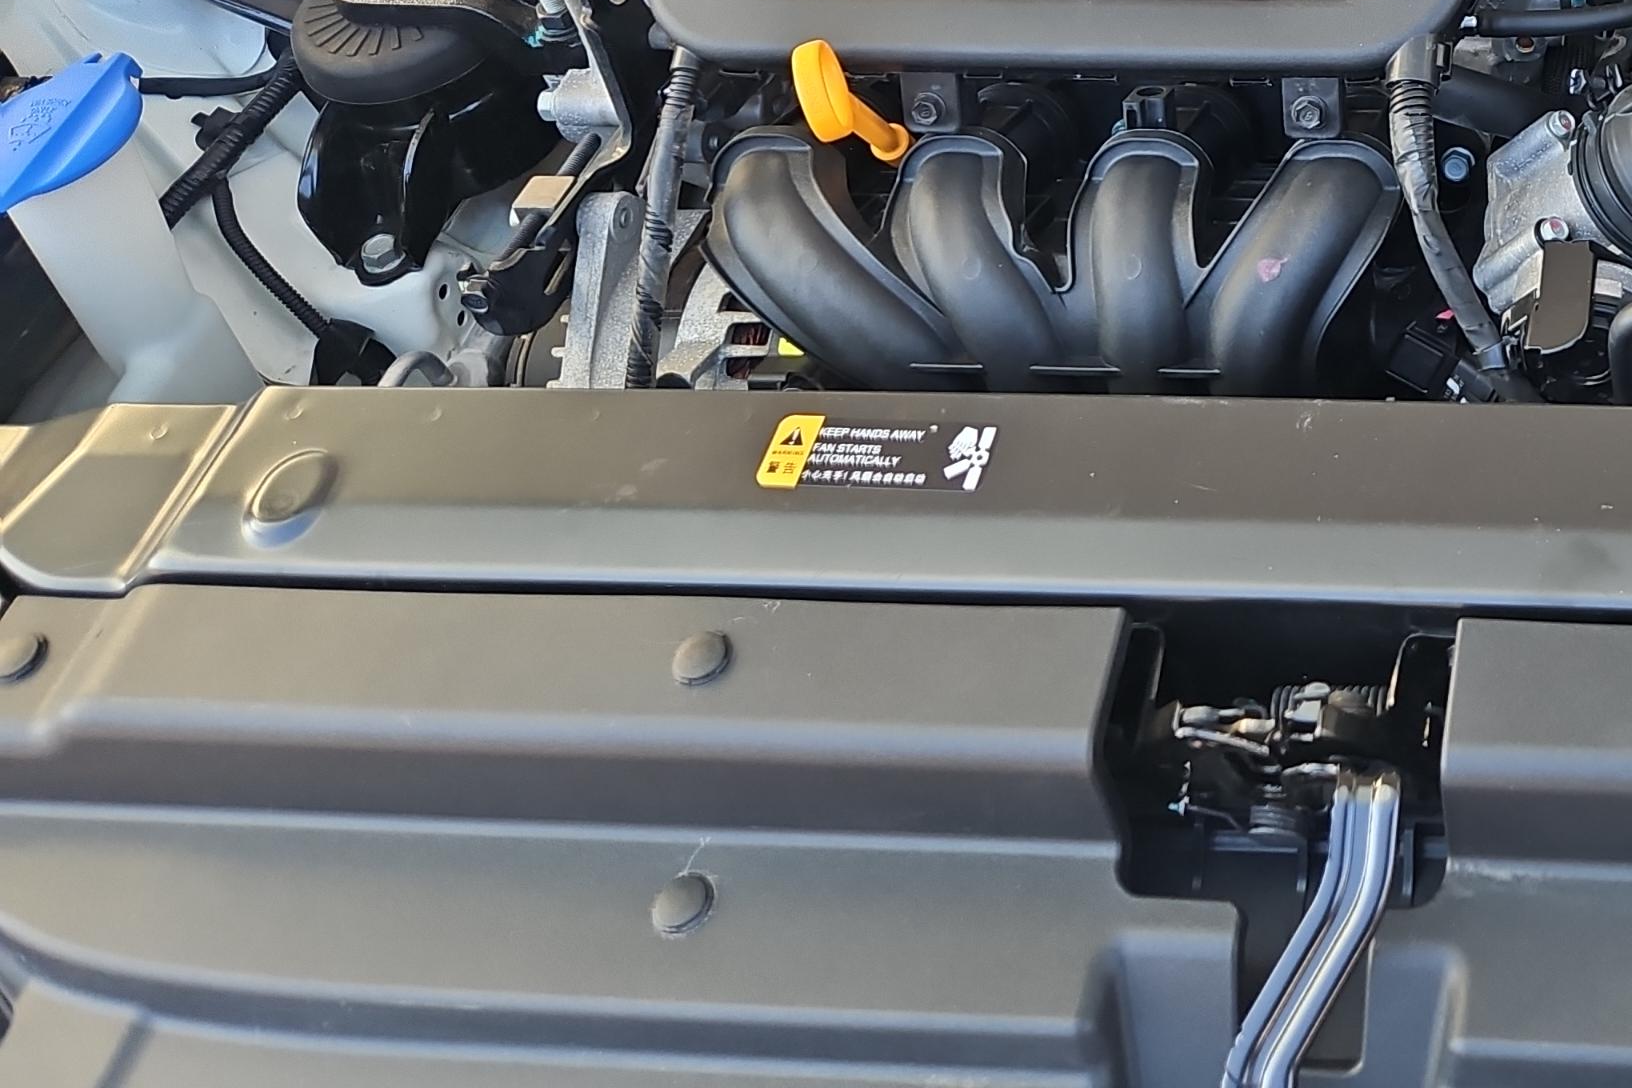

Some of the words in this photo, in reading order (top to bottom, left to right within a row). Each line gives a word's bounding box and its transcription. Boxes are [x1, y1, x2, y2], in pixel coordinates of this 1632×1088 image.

[819, 427, 851, 438] KEEP
[850, 428, 890, 440] HANDS
[890, 429, 926, 441] AWAY
[812, 443, 836, 453] FAN
[836, 443, 882, 455] STARTS
[807, 454, 901, 468] AUTOMATICALLY
